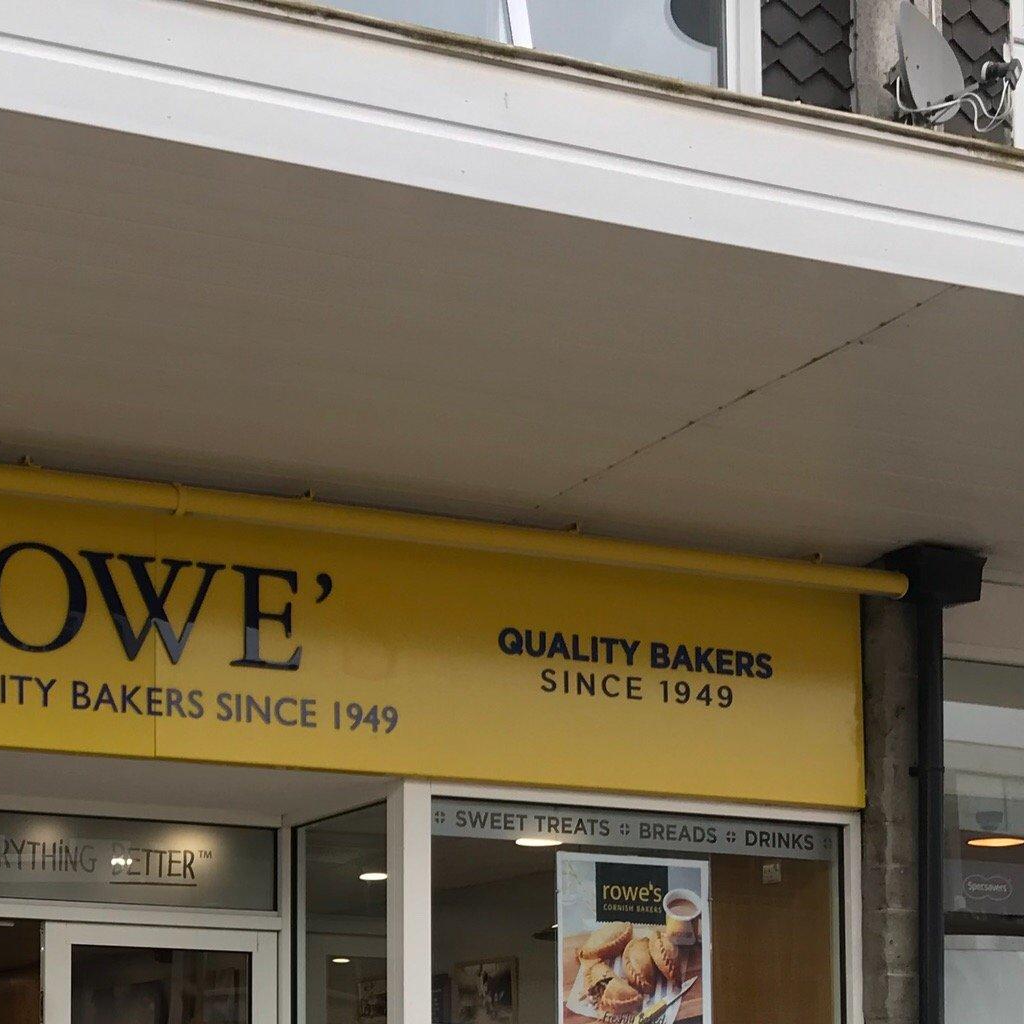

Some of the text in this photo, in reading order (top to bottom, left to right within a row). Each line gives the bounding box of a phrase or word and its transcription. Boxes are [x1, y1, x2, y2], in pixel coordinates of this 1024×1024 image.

[498, 627, 773, 679] QUALITY BAKERS
[72, 680, 204, 719] BAKERS
[217, 692, 317, 729] SINCE
[334, 700, 398, 734] 1949
[541, 669, 734, 708] SINCE 1949
[455, 810, 814, 851] SWEET TREATS BREADS DRINKS
[603, 881, 662, 902] rowe's
